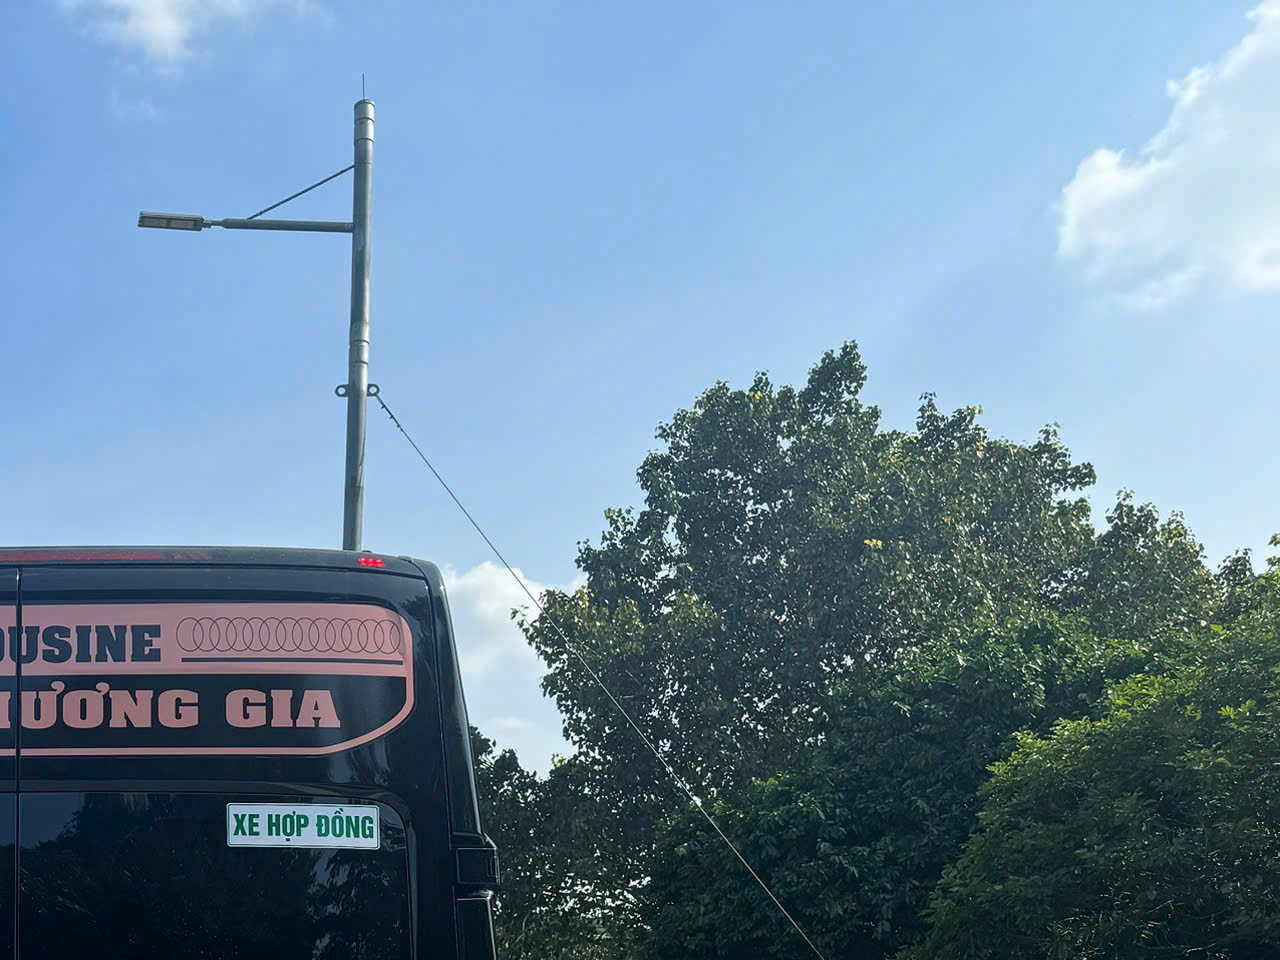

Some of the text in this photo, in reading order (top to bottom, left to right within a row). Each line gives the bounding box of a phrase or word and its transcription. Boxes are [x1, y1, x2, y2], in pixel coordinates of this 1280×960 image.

[225, 689, 341, 729] GIA
[233, 808, 374, 842] XE HỢP ĐỒNG
